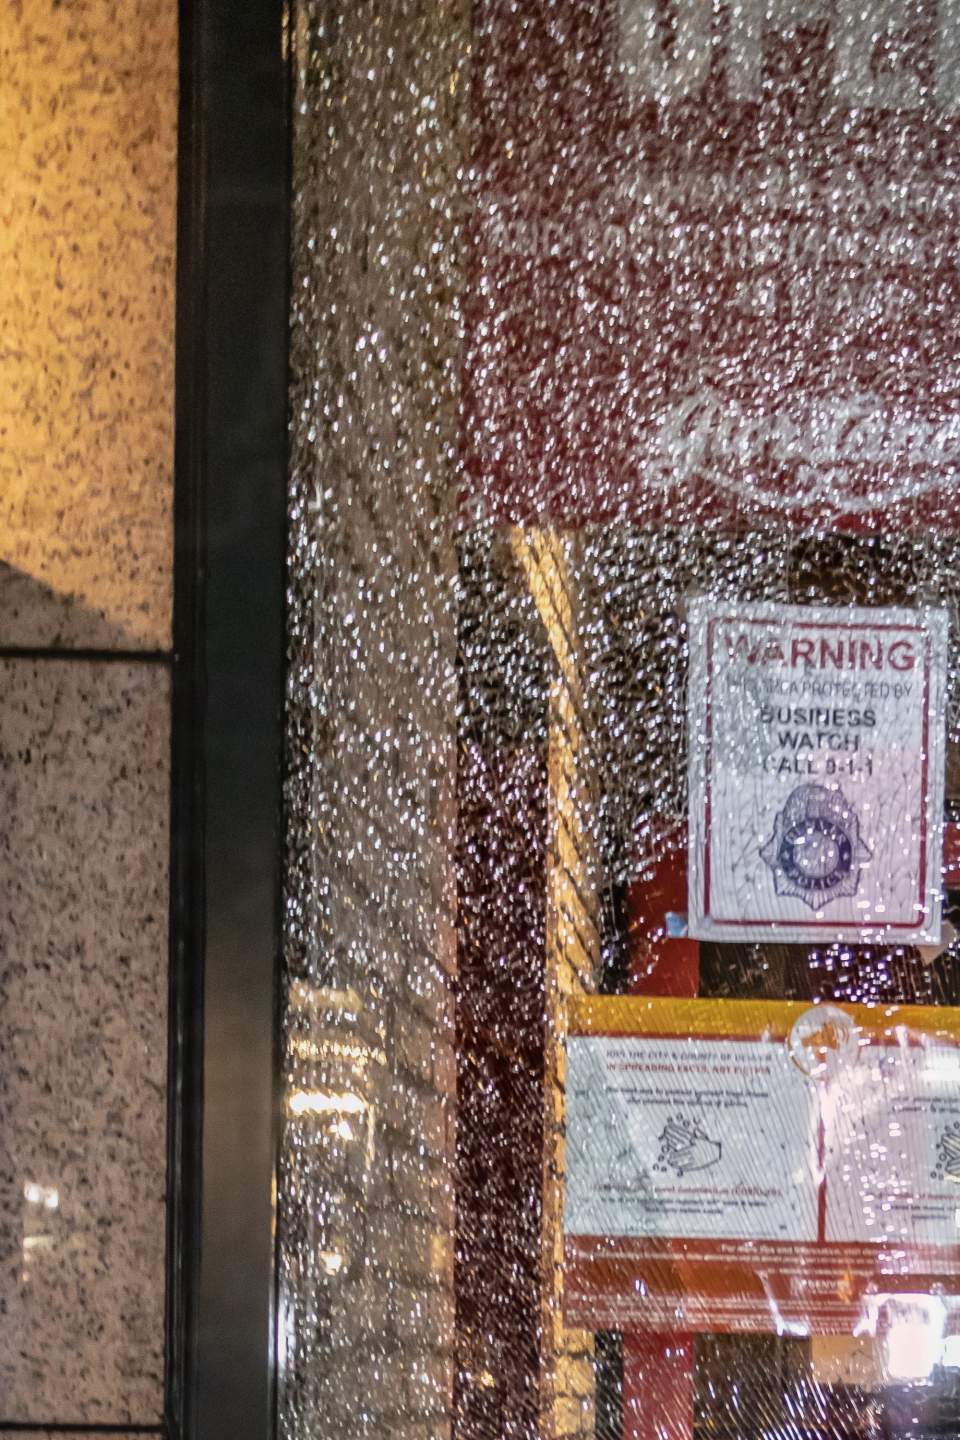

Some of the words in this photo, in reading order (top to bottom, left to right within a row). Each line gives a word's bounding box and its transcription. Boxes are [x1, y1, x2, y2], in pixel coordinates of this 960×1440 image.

[725, 634, 915, 671] WARNING
[760, 705, 877, 728] BUSINESS
[778, 731, 860, 751] WATCH
[763, 757, 818, 775] CALL
